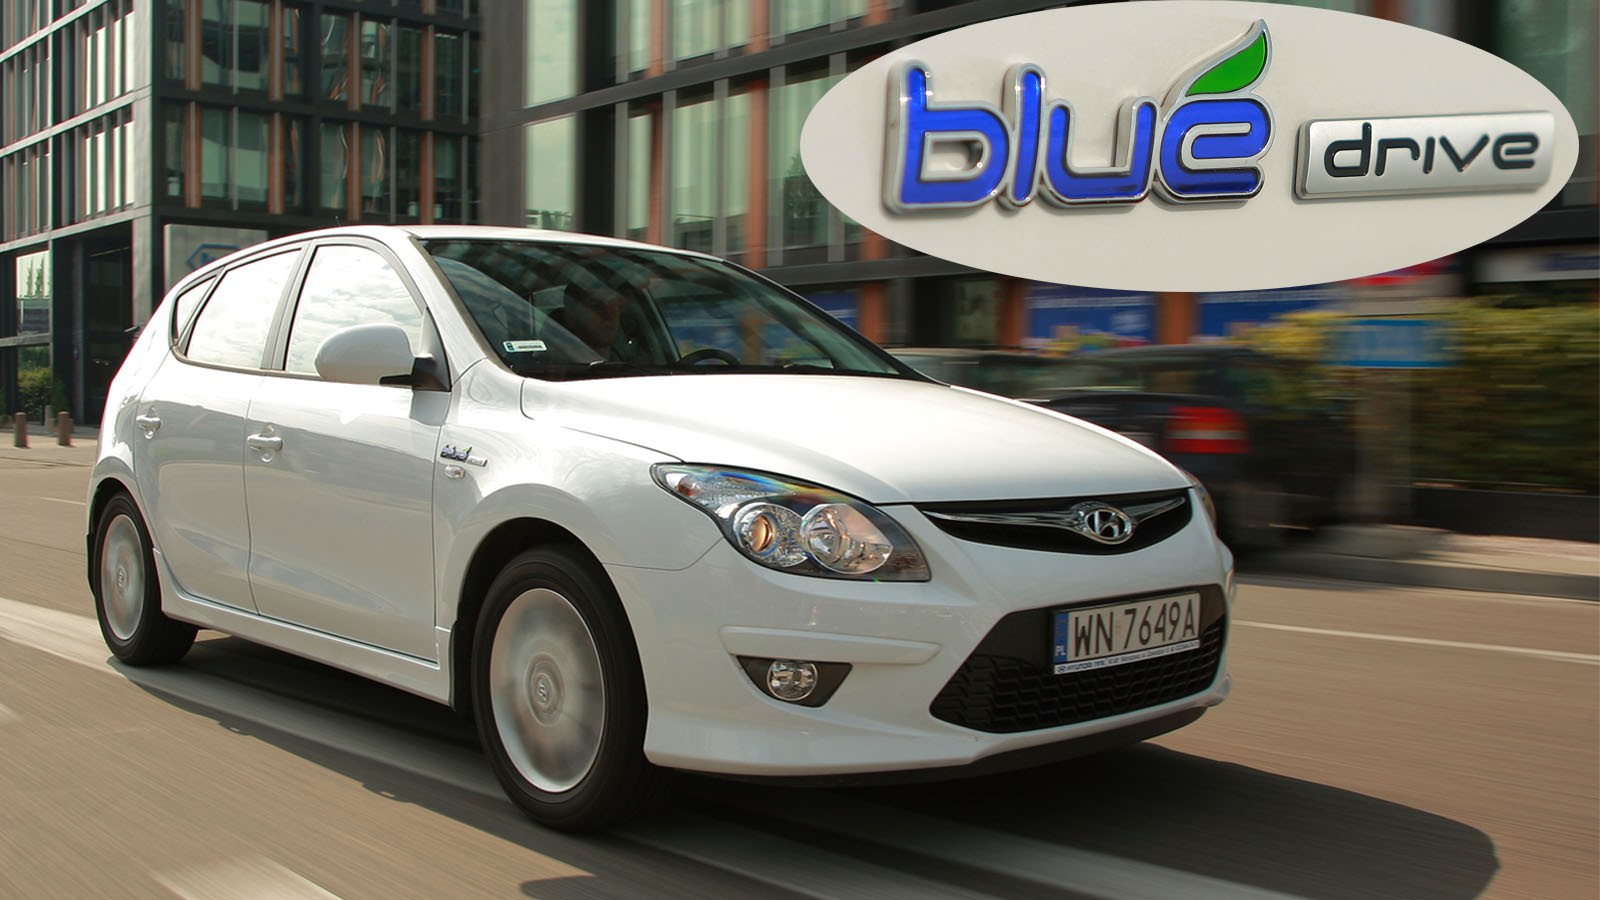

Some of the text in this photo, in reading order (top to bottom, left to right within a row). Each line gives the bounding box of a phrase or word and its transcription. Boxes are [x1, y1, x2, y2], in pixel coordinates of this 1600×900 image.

[885, 58, 1541, 212] blue drive
[1055, 645, 1066, 656] PL
[1074, 611, 1114, 657] WN
[1124, 599, 1195, 650] 7649A
